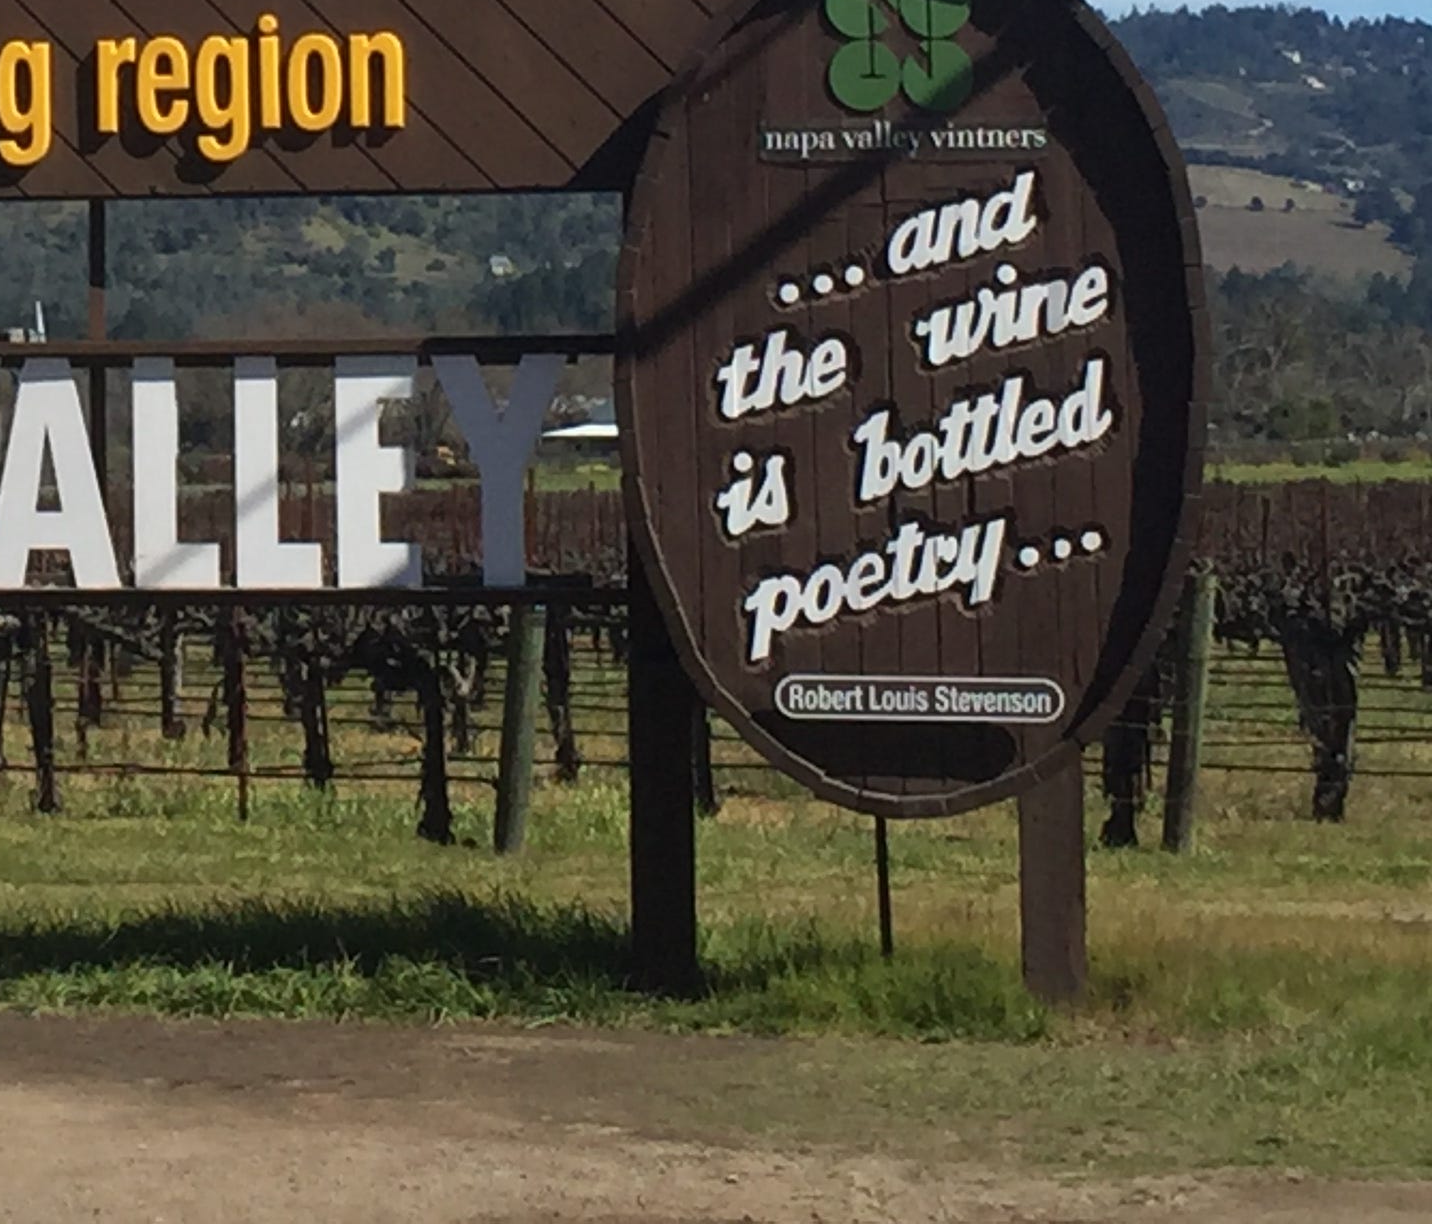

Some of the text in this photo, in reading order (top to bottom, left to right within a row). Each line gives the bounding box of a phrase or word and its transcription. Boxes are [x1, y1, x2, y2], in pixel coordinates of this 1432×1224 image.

[97, 13, 405, 162] region
[766, 120, 1048, 158] napa valley vintners
[718, 263, 1108, 420] the wine
[717, 359, 1112, 536] is bottled
[788, 684, 1052, 714] Robert Louis Stevenson
